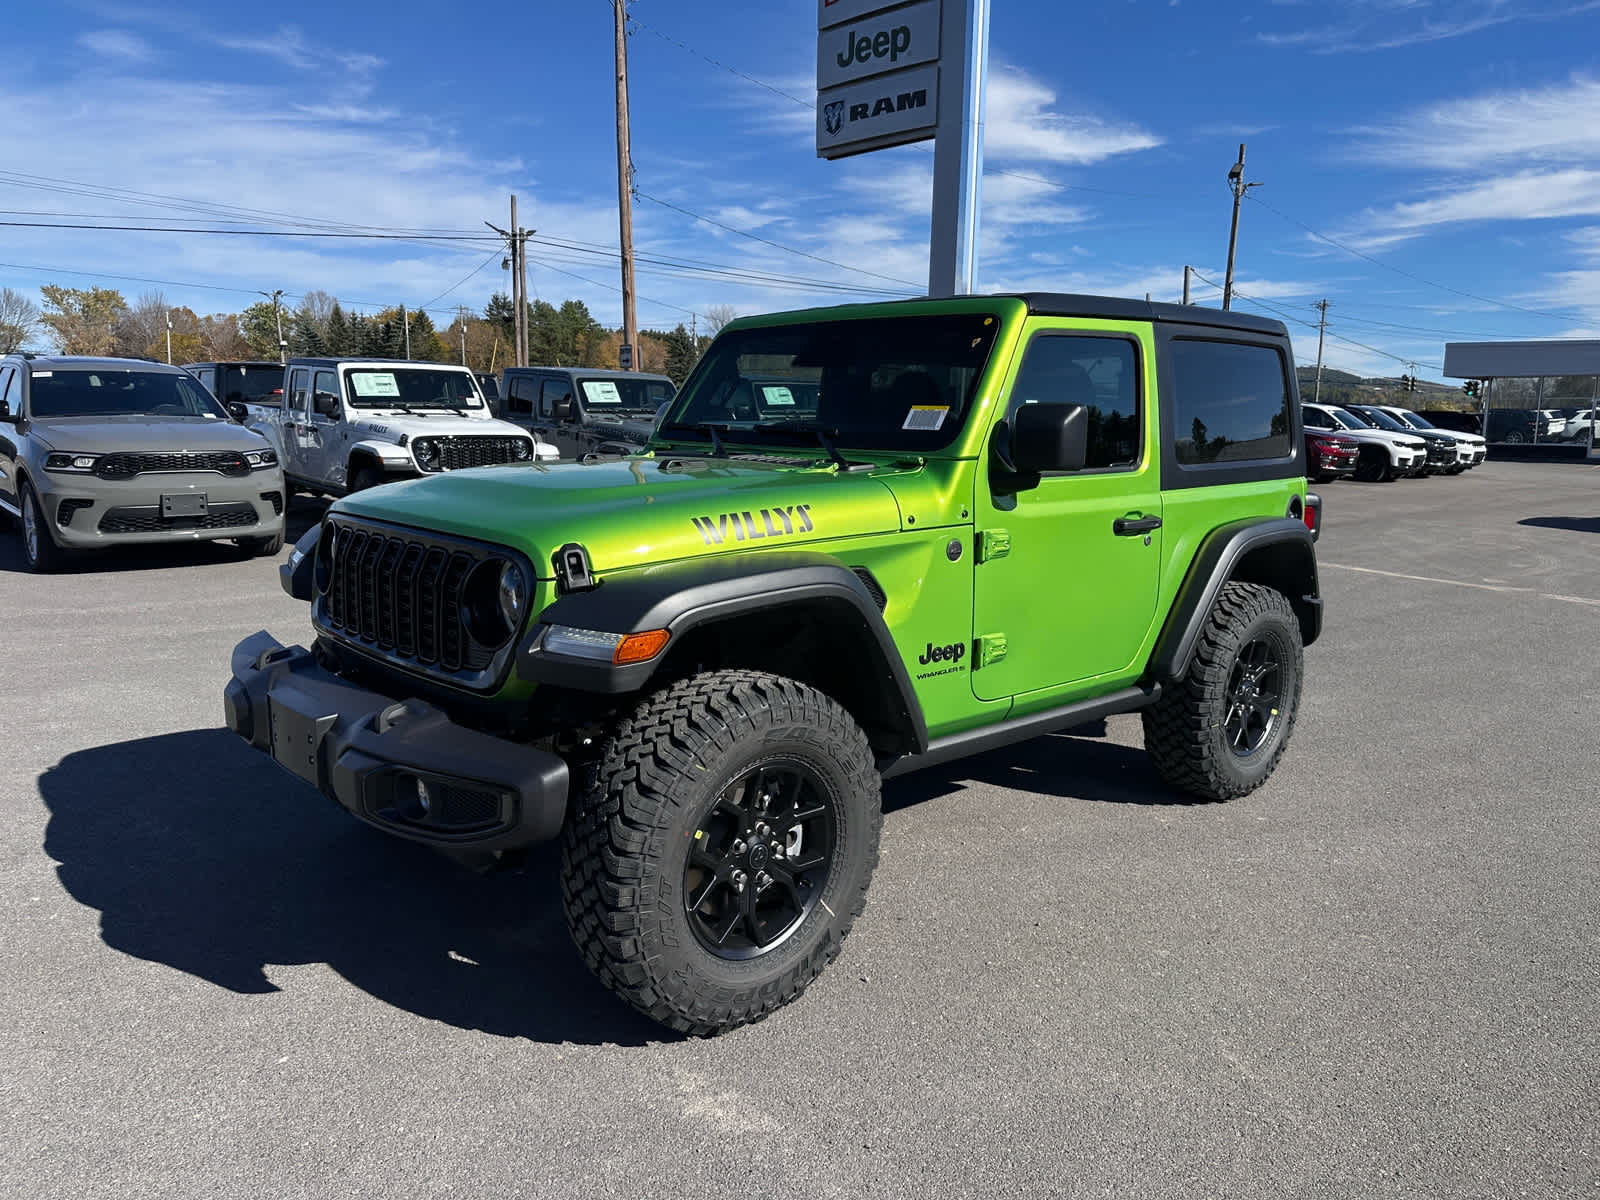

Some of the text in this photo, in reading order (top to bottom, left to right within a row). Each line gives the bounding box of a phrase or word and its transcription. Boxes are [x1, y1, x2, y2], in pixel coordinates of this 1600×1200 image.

[836, 25, 911, 68] Jeep
[849, 88, 926, 122] RAM
[691, 504, 814, 545] WILLYS
[918, 641, 966, 665] Jeep
